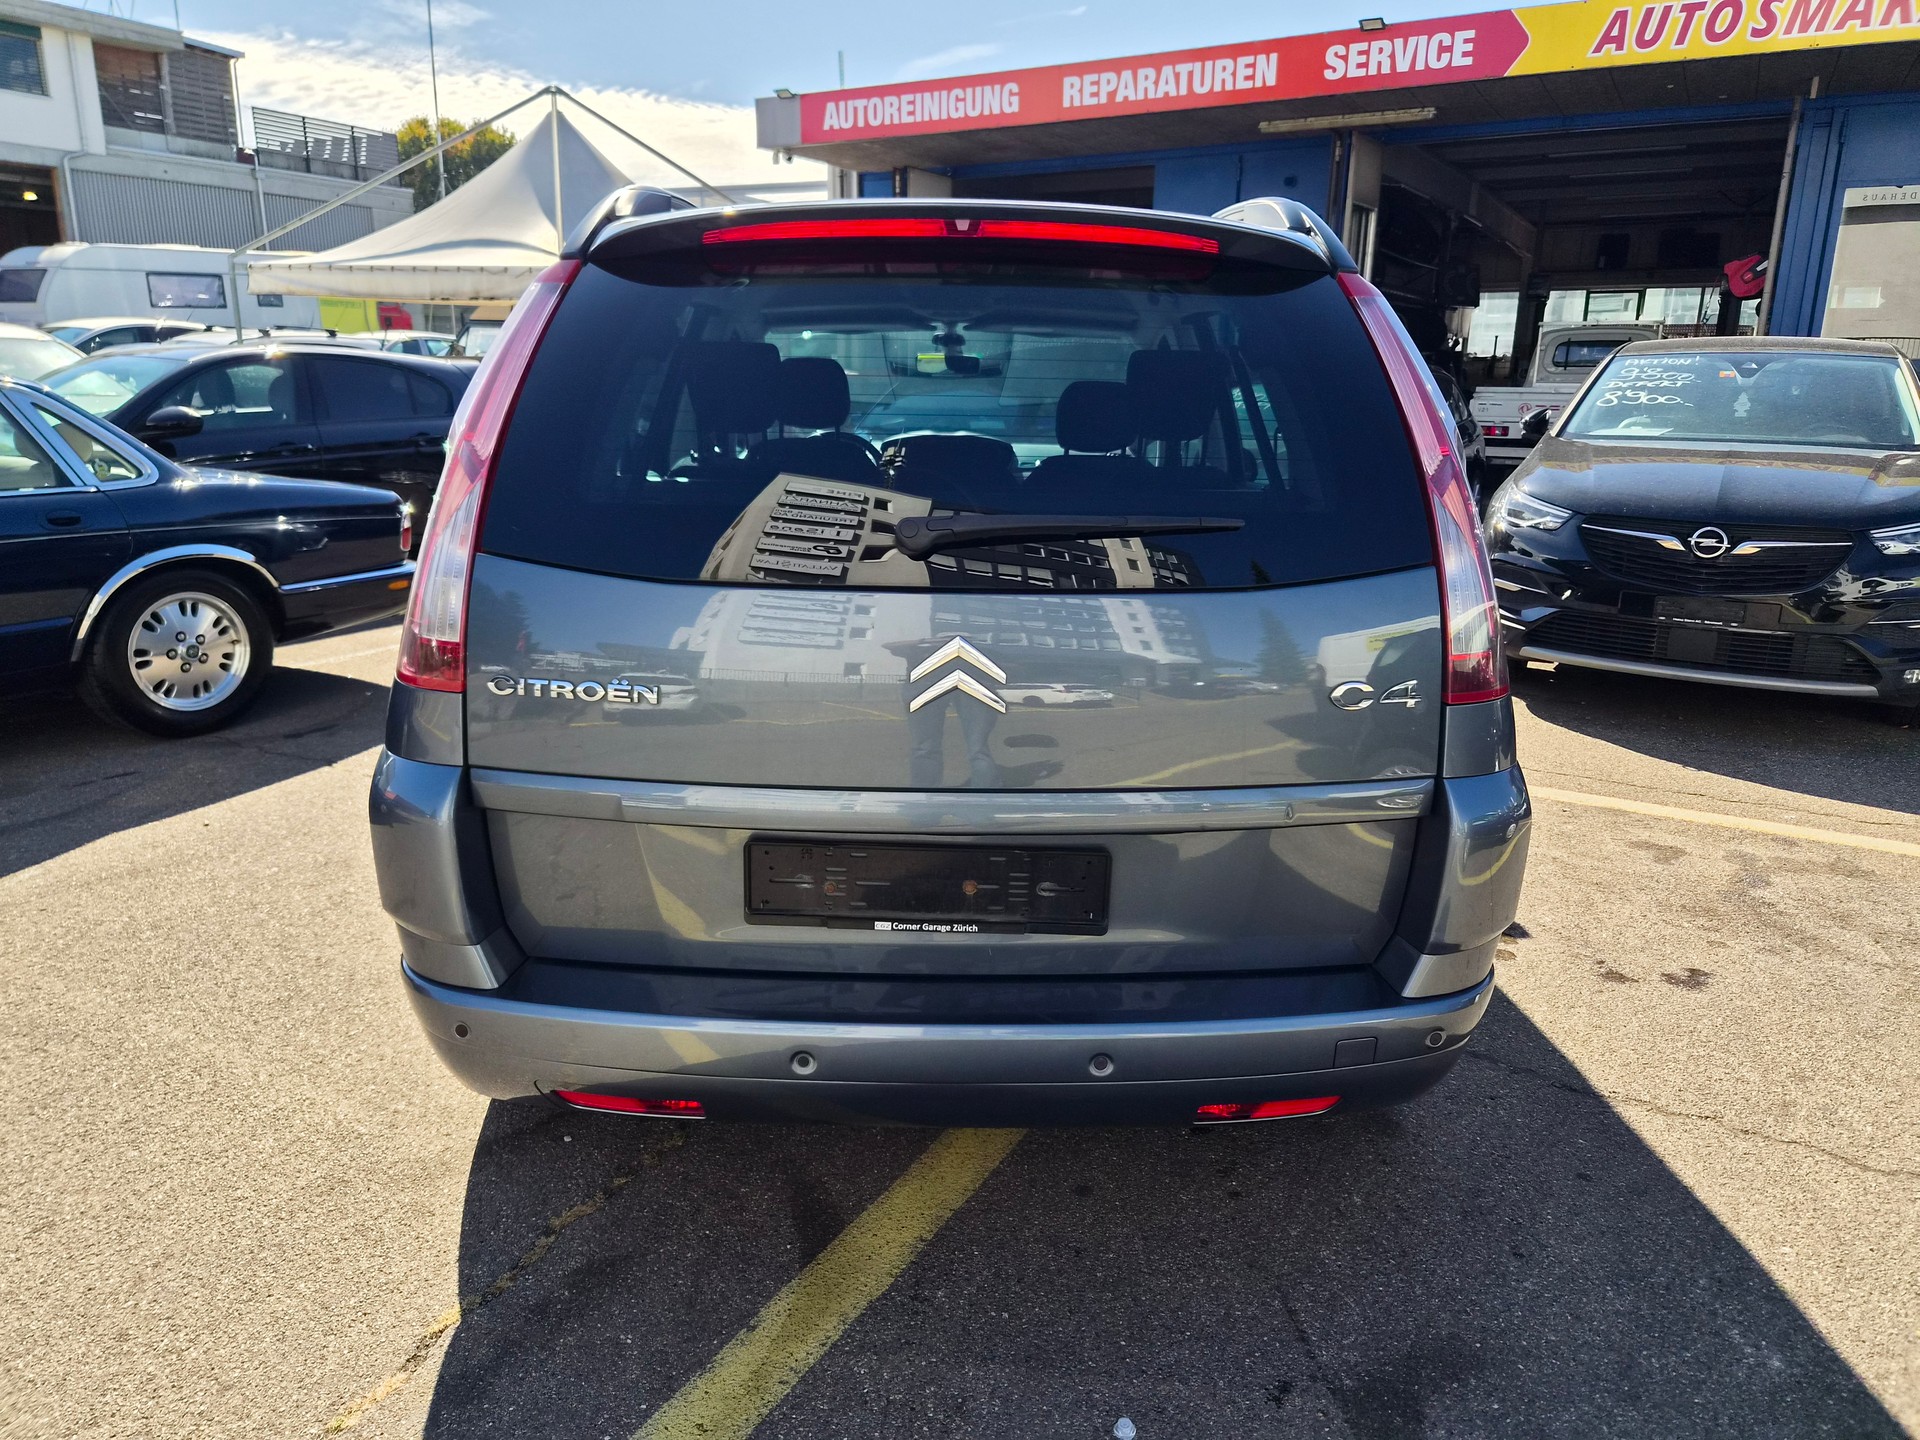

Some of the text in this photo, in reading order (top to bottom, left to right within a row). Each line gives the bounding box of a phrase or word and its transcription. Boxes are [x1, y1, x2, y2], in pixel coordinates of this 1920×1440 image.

[1323, 30, 1475, 81] SERVICE
[1062, 53, 1278, 108] REPARATUREN
[822, 82, 1020, 131] AUTOREINIGUNG
[486, 674, 659, 705] CITROËN
[893, 922, 921, 931] Corner
[922, 923, 951, 932] Garage
[953, 923, 978, 932] Zürich
